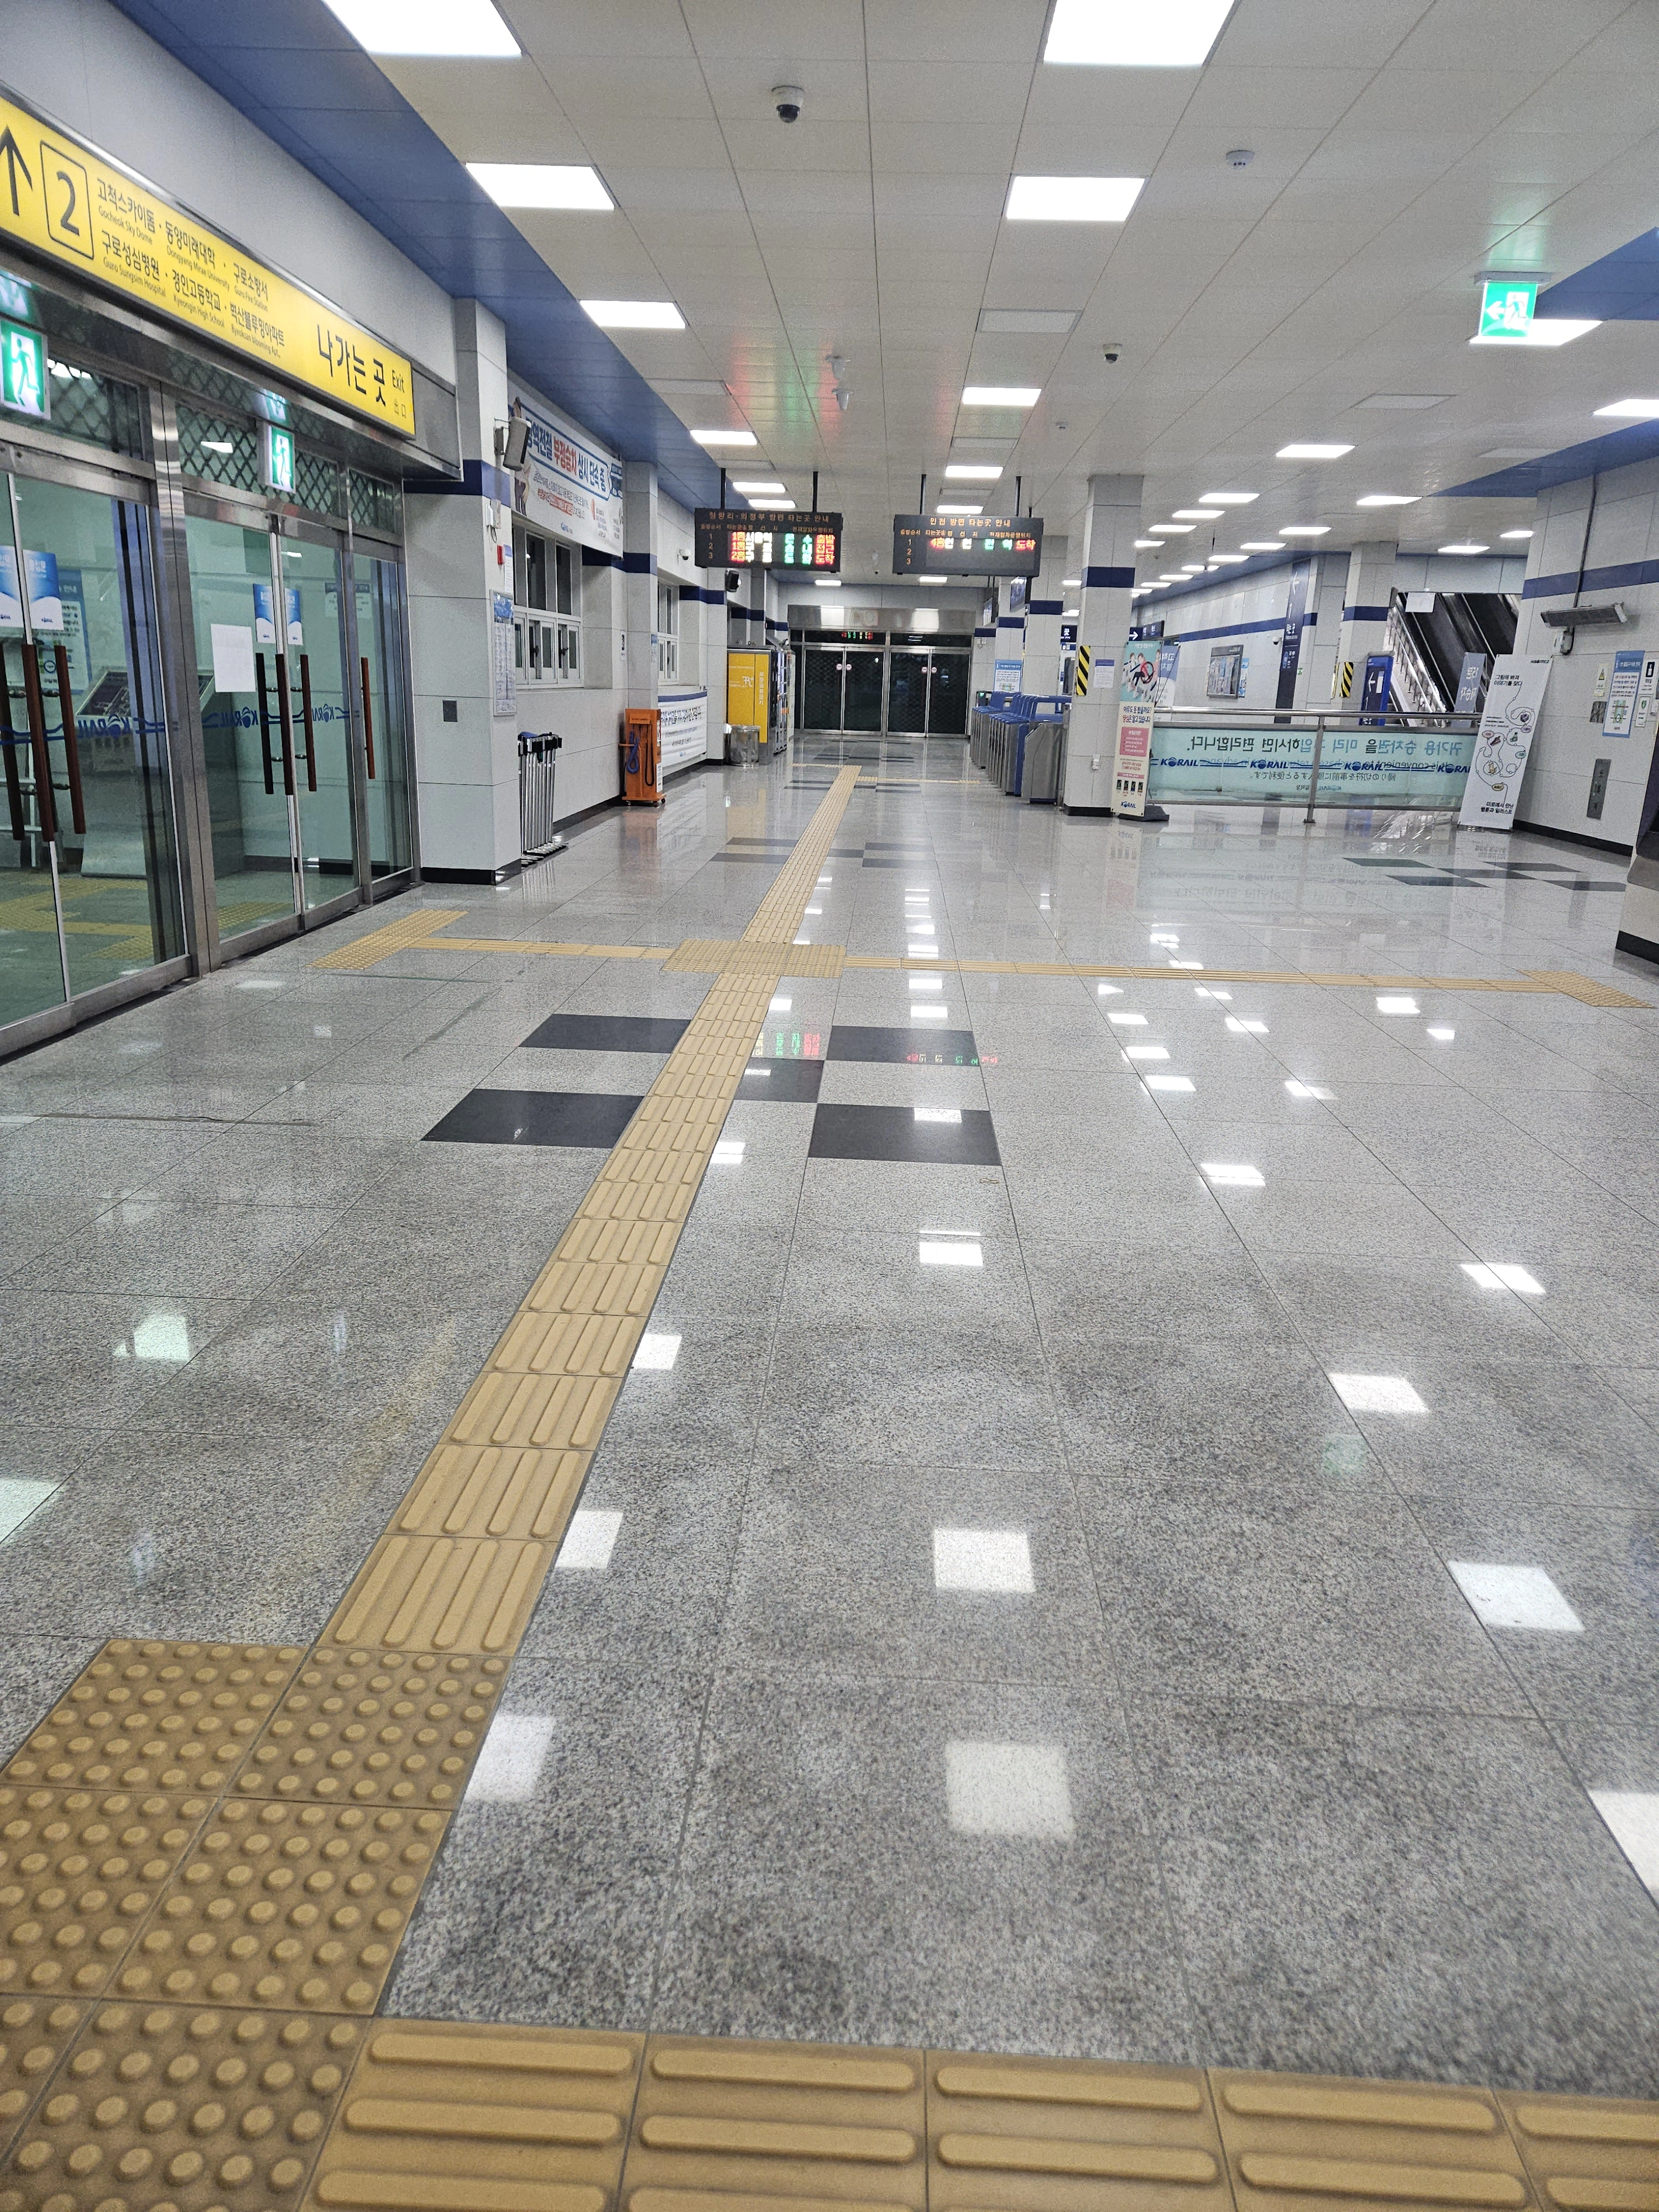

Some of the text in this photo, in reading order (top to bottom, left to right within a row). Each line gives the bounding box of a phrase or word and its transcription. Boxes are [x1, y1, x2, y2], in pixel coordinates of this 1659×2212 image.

[56, 169, 81, 237] 2
[97, 177, 268, 301] 고척스카이돔 동양미래대학 구로소방서
[126, 220, 135, 237] Sky
[137, 227, 153, 244] Dome
[166, 245, 192, 271] Dongyang
[207, 271, 229, 291] University
[101, 229, 285, 347] 구로성심병원 경인고등학교 벽산블루밍아파트
[103, 256, 118, 273] Guro
[119, 265, 143, 285] Sungsim
[144, 276, 166, 298] Hospital
[197, 305, 209, 320] High
[210, 312, 225, 328] School
[317, 323, 386, 407] 나가는 곳
[392, 369, 405, 393] Exit
[393, 398, 407, 419] 出口
[554, 436, 577, 476] 부정승차
[578, 453, 588, 483] 상시
[589, 460, 599, 489] 단속
[600, 467, 606, 492] 중
[815, 514, 829, 523] 안내
[930, 517, 946, 525] 인천
[950, 518, 965, 526] 방면
[995, 519, 1011, 528] 안내
[1016, 539, 1036, 551] 도착
[1160, 757, 1199, 767] KORAIL
[1250, 759, 1288, 769] KORAIL
[1344, 761, 1383, 771] KORAIL
[1437, 763, 1470, 774] KORAI
